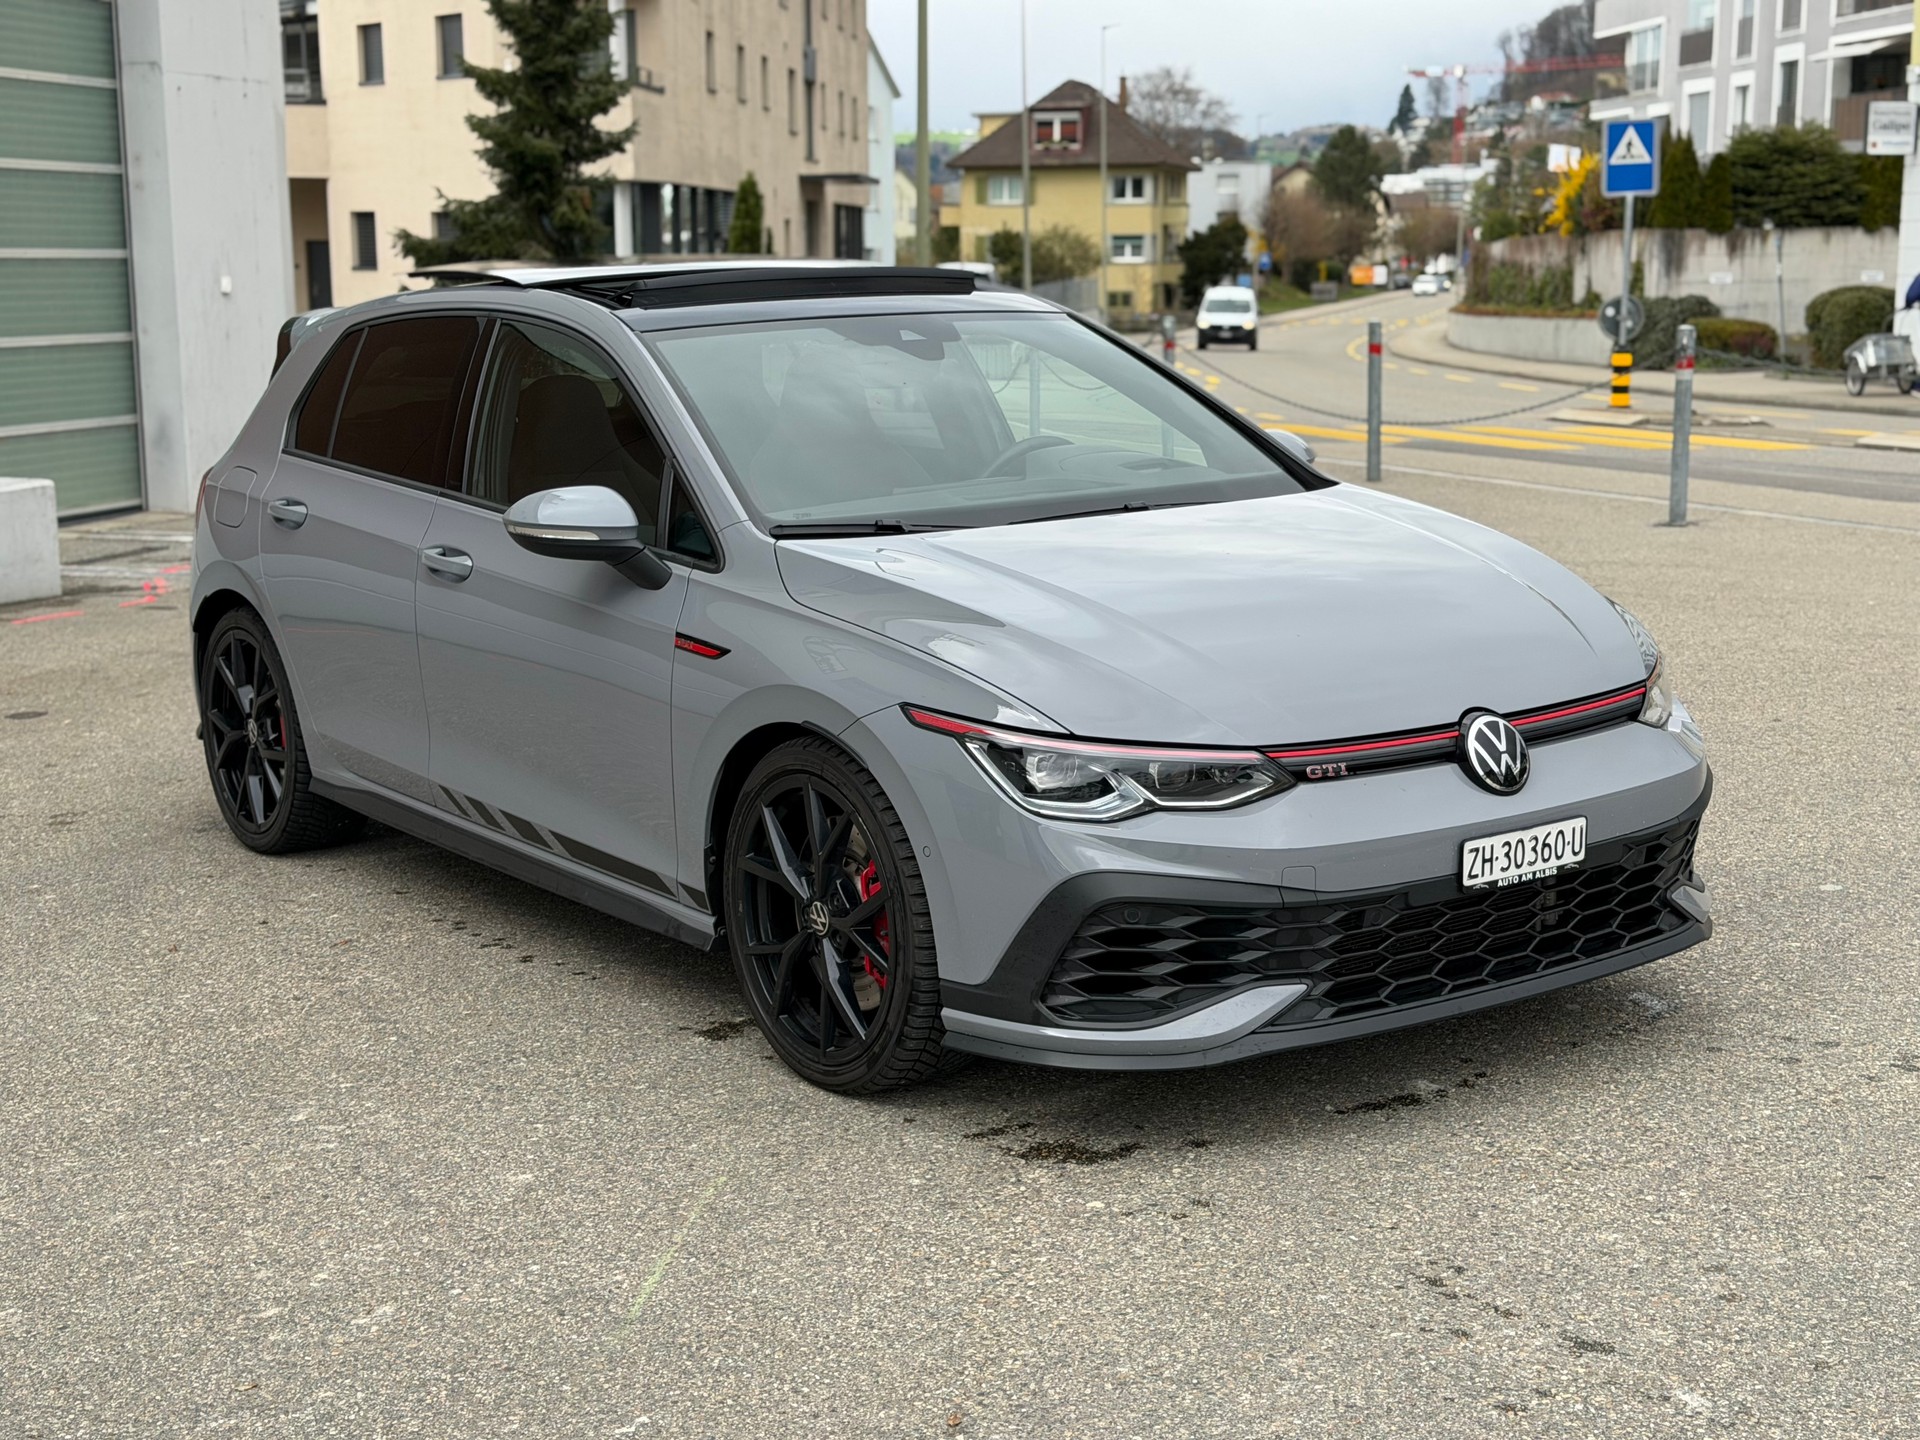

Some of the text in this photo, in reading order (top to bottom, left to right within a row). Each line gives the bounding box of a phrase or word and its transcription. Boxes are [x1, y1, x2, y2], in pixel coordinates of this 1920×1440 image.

[1306, 762, 1348, 779] GTI
[1497, 867, 1558, 887] AUTO AM ALBIS
